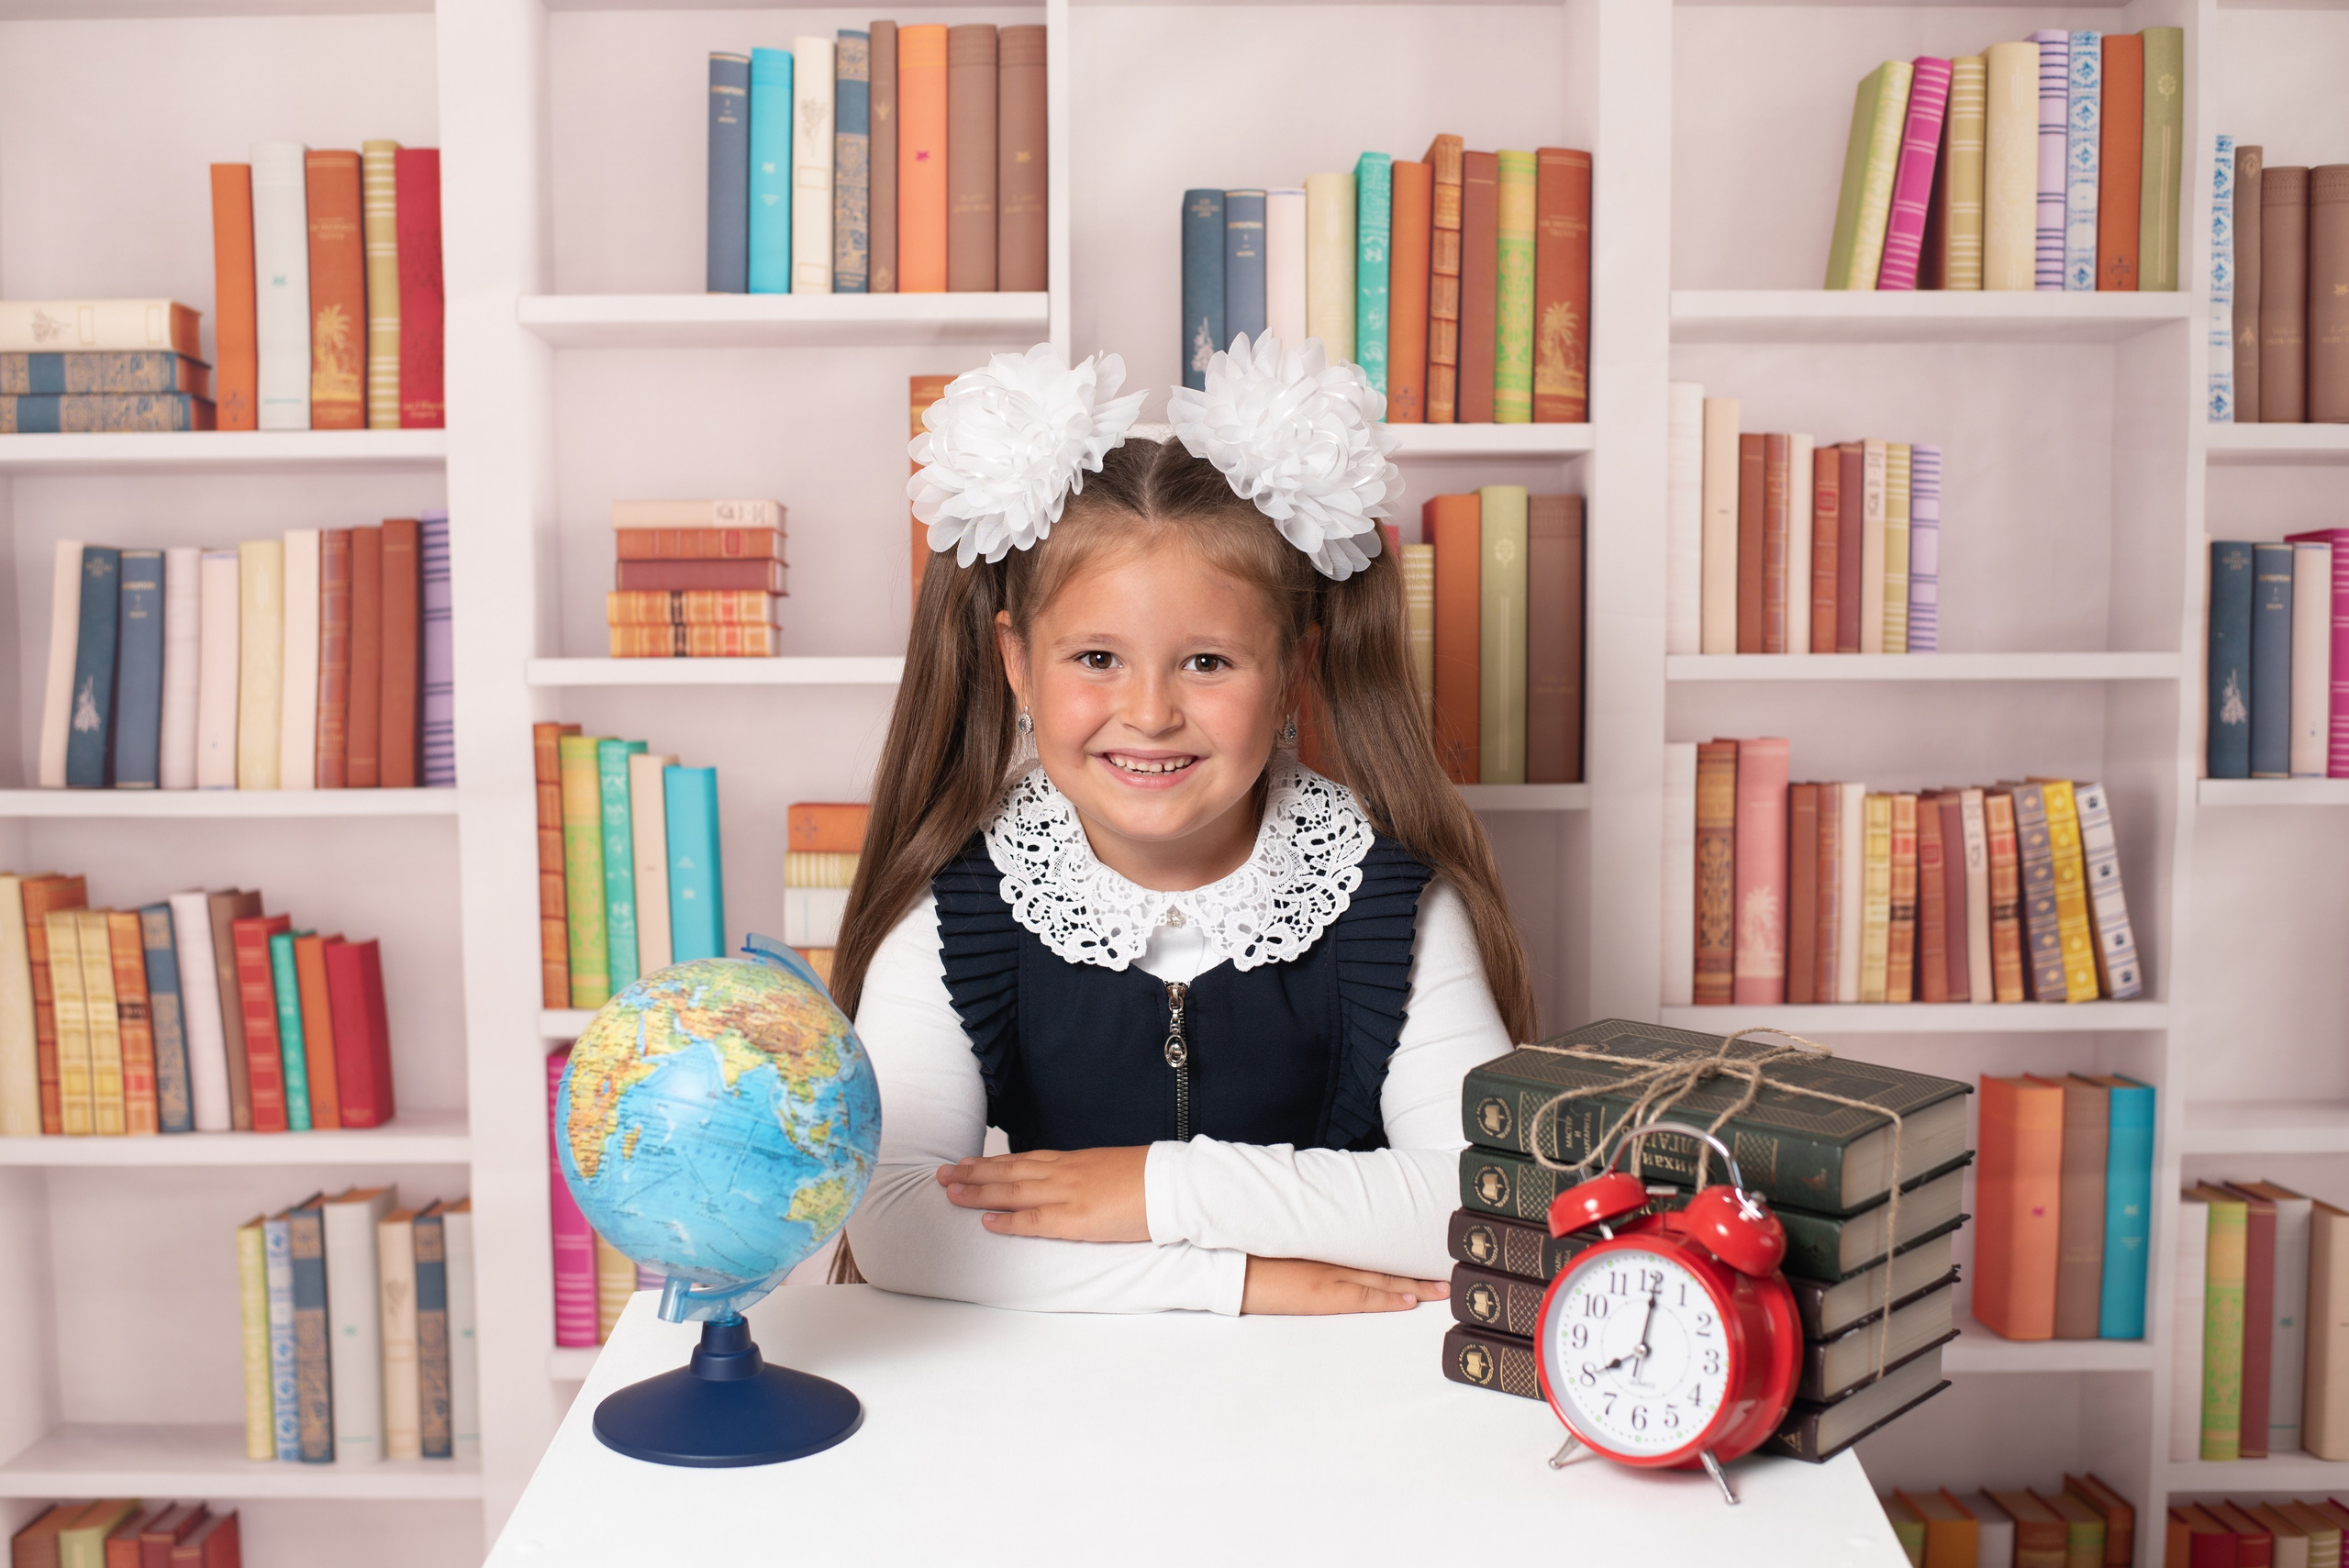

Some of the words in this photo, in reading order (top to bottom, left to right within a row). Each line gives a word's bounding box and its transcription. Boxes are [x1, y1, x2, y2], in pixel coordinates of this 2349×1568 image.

[1564, 1115, 1574, 1149] МАСТЕР
[1575, 1130, 1582, 1139] И
[1609, 1271, 1628, 1296] 11
[1639, 1268, 1664, 1295] 12
[1585, 1293, 1608, 1319] 10
[1678, 1284, 1687, 1307] 1
[1572, 1323, 1588, 1350] 9
[1696, 1312, 1712, 1338] 2
[1704, 1349, 1720, 1374] 3
[1580, 1362, 1598, 1387] 8
[1603, 1392, 1618, 1416] 7
[1687, 1383, 1703, 1407] 4
[1631, 1405, 1648, 1431] 6
[1664, 1404, 1679, 1429] 5
